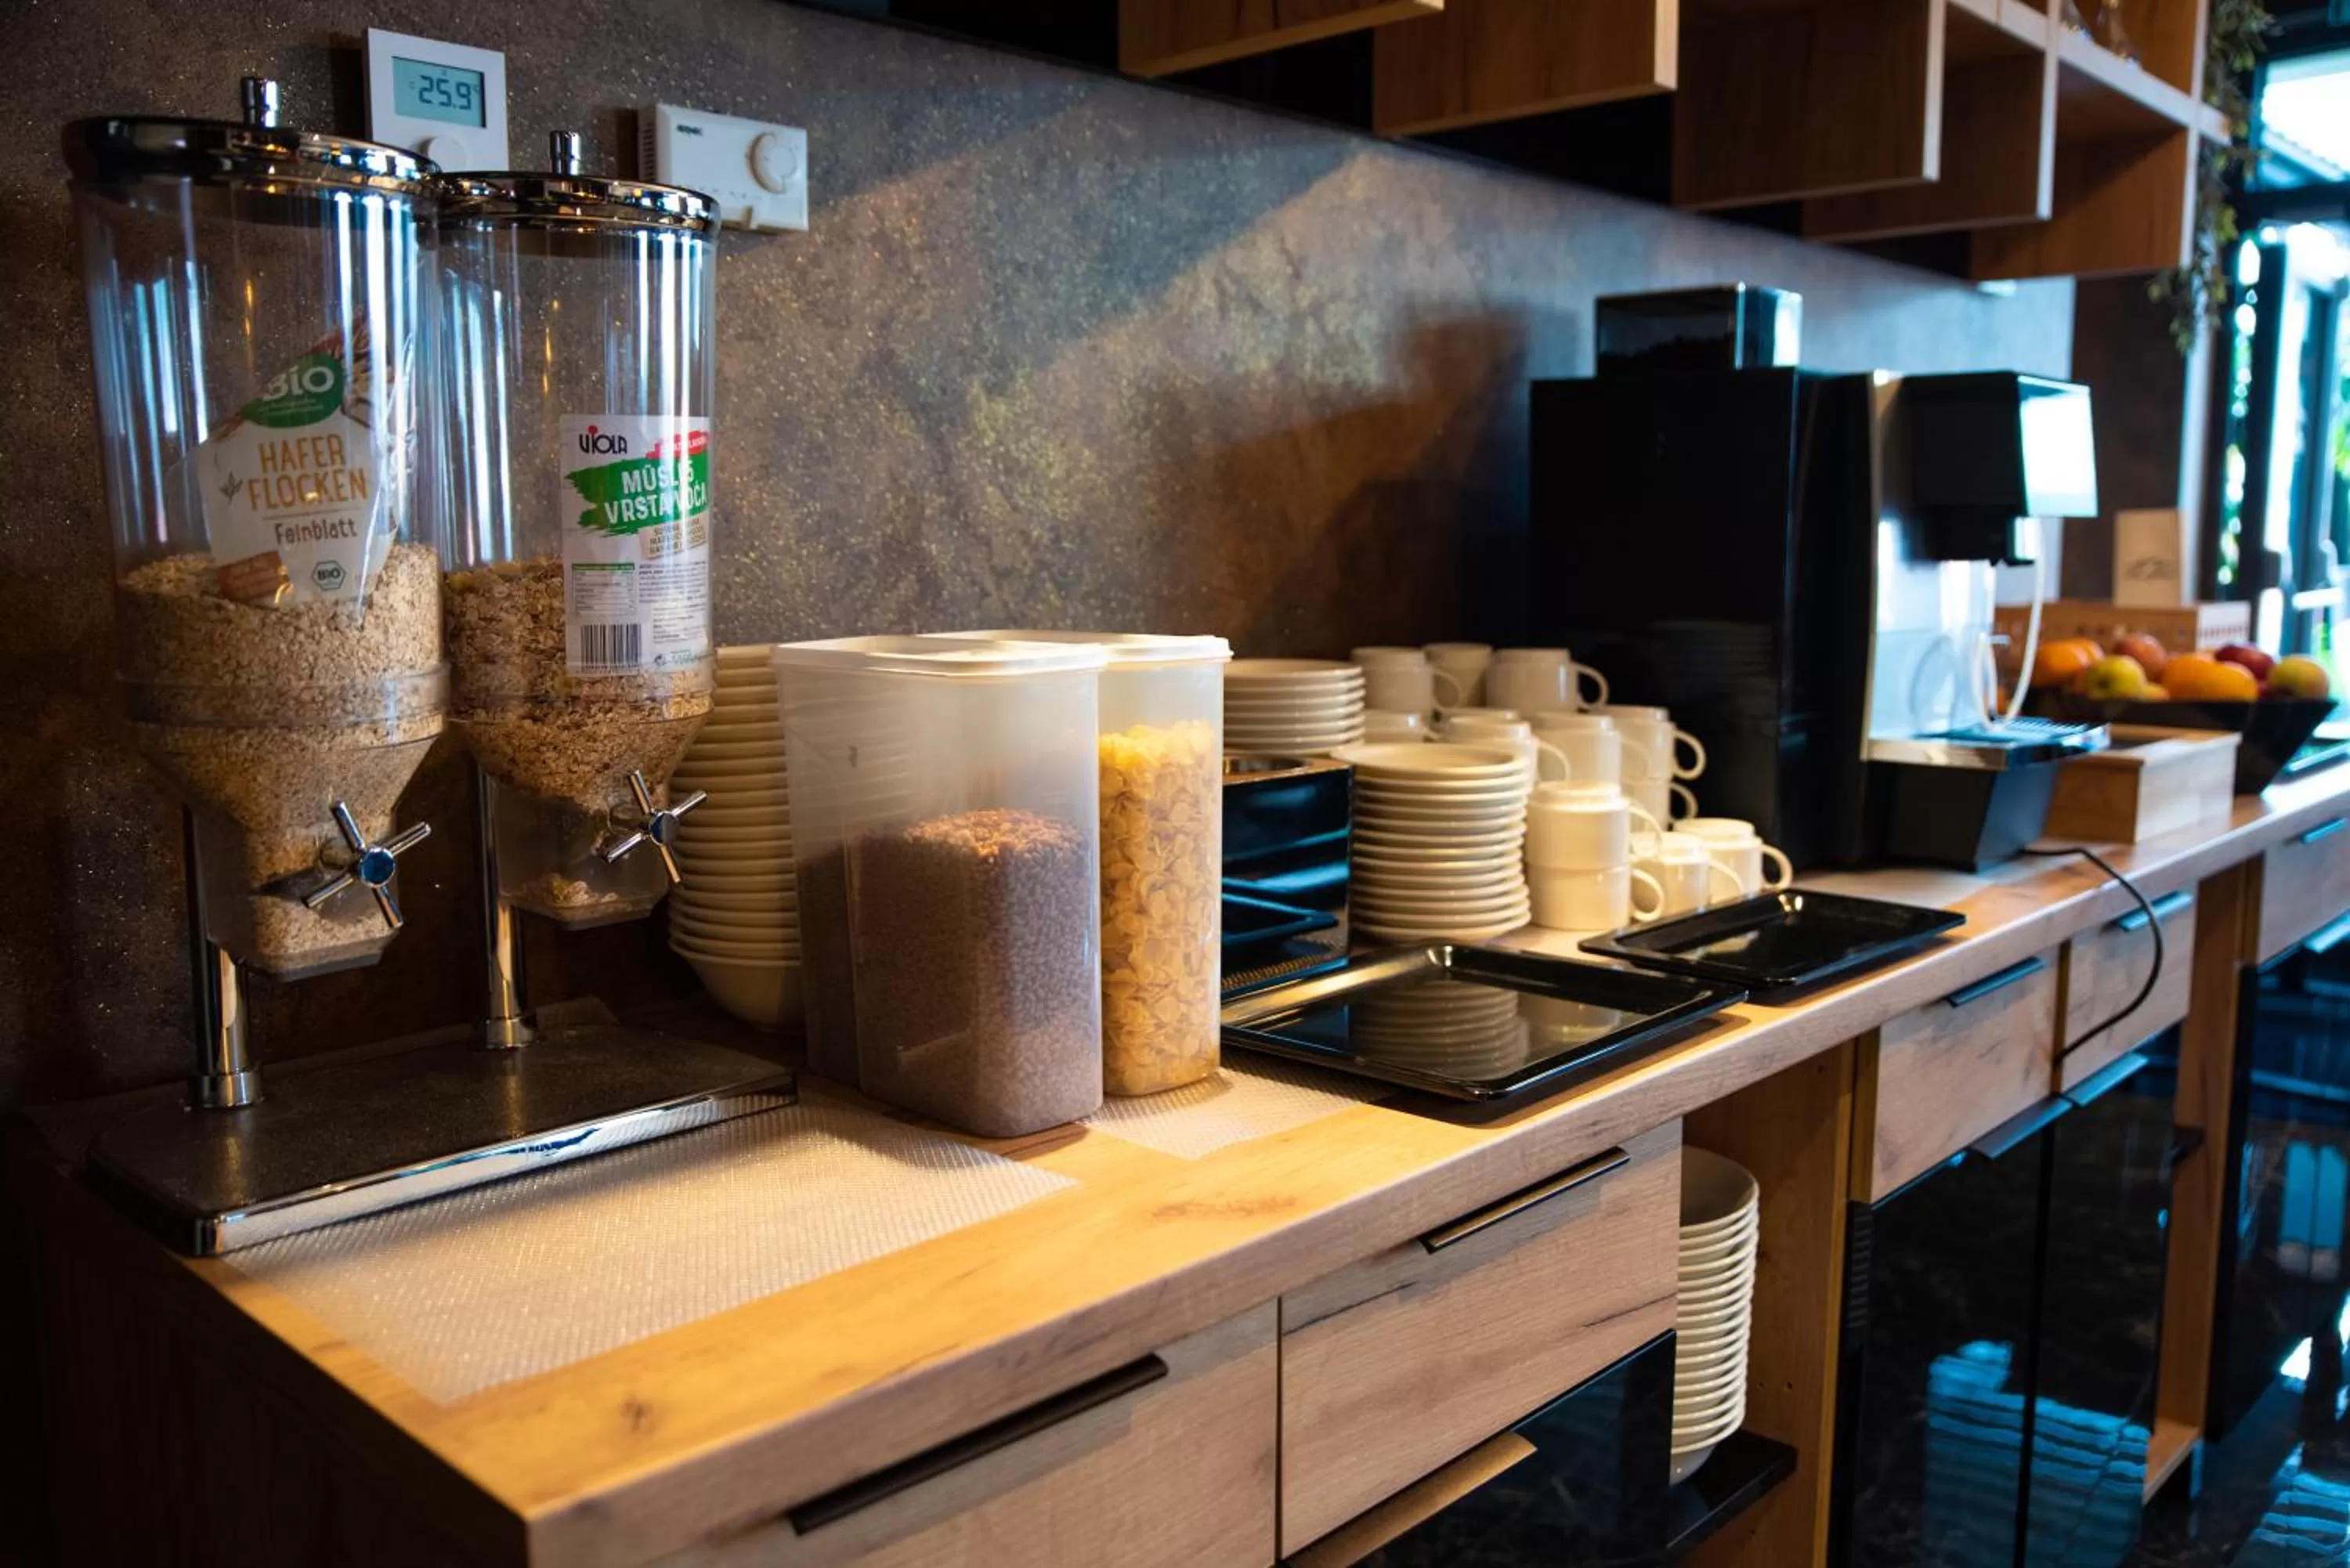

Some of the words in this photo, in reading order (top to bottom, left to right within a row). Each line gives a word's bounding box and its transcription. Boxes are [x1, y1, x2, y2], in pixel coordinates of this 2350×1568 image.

[419, 74, 472, 110] 25.9
[258, 434, 346, 473] HAFER
[248, 468, 367, 511] FLOCKEN
[605, 493, 673, 524] VRSTA
[275, 518, 358, 544] Feinblatt
